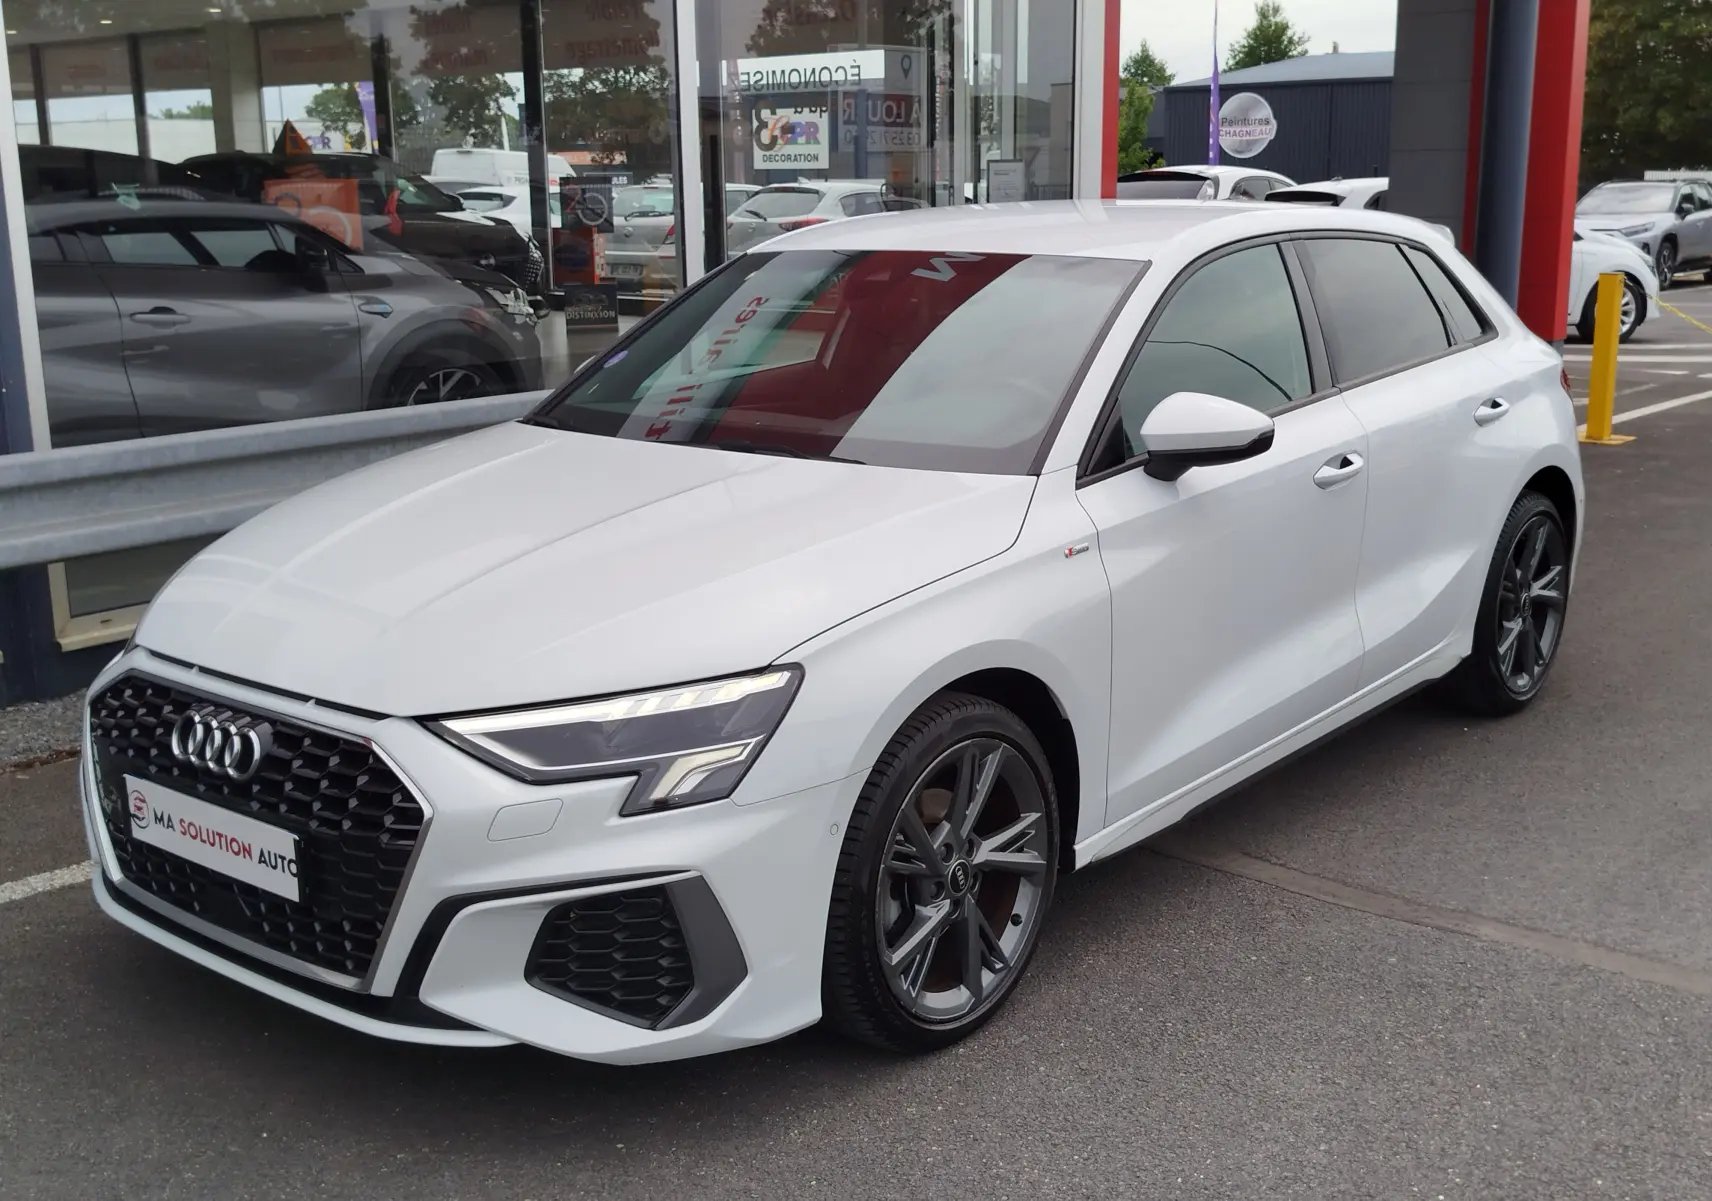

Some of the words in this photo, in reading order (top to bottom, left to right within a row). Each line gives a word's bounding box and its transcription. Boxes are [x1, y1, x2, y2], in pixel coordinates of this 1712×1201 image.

[1221, 117, 1270, 127] Peintures
[1219, 127, 1271, 138] CHAGNEAU
[762, 153, 819, 163] DECORATION
[153, 808, 176, 832] MA
[179, 817, 253, 861] SOLUTION
[257, 847, 298, 879] AUTO
